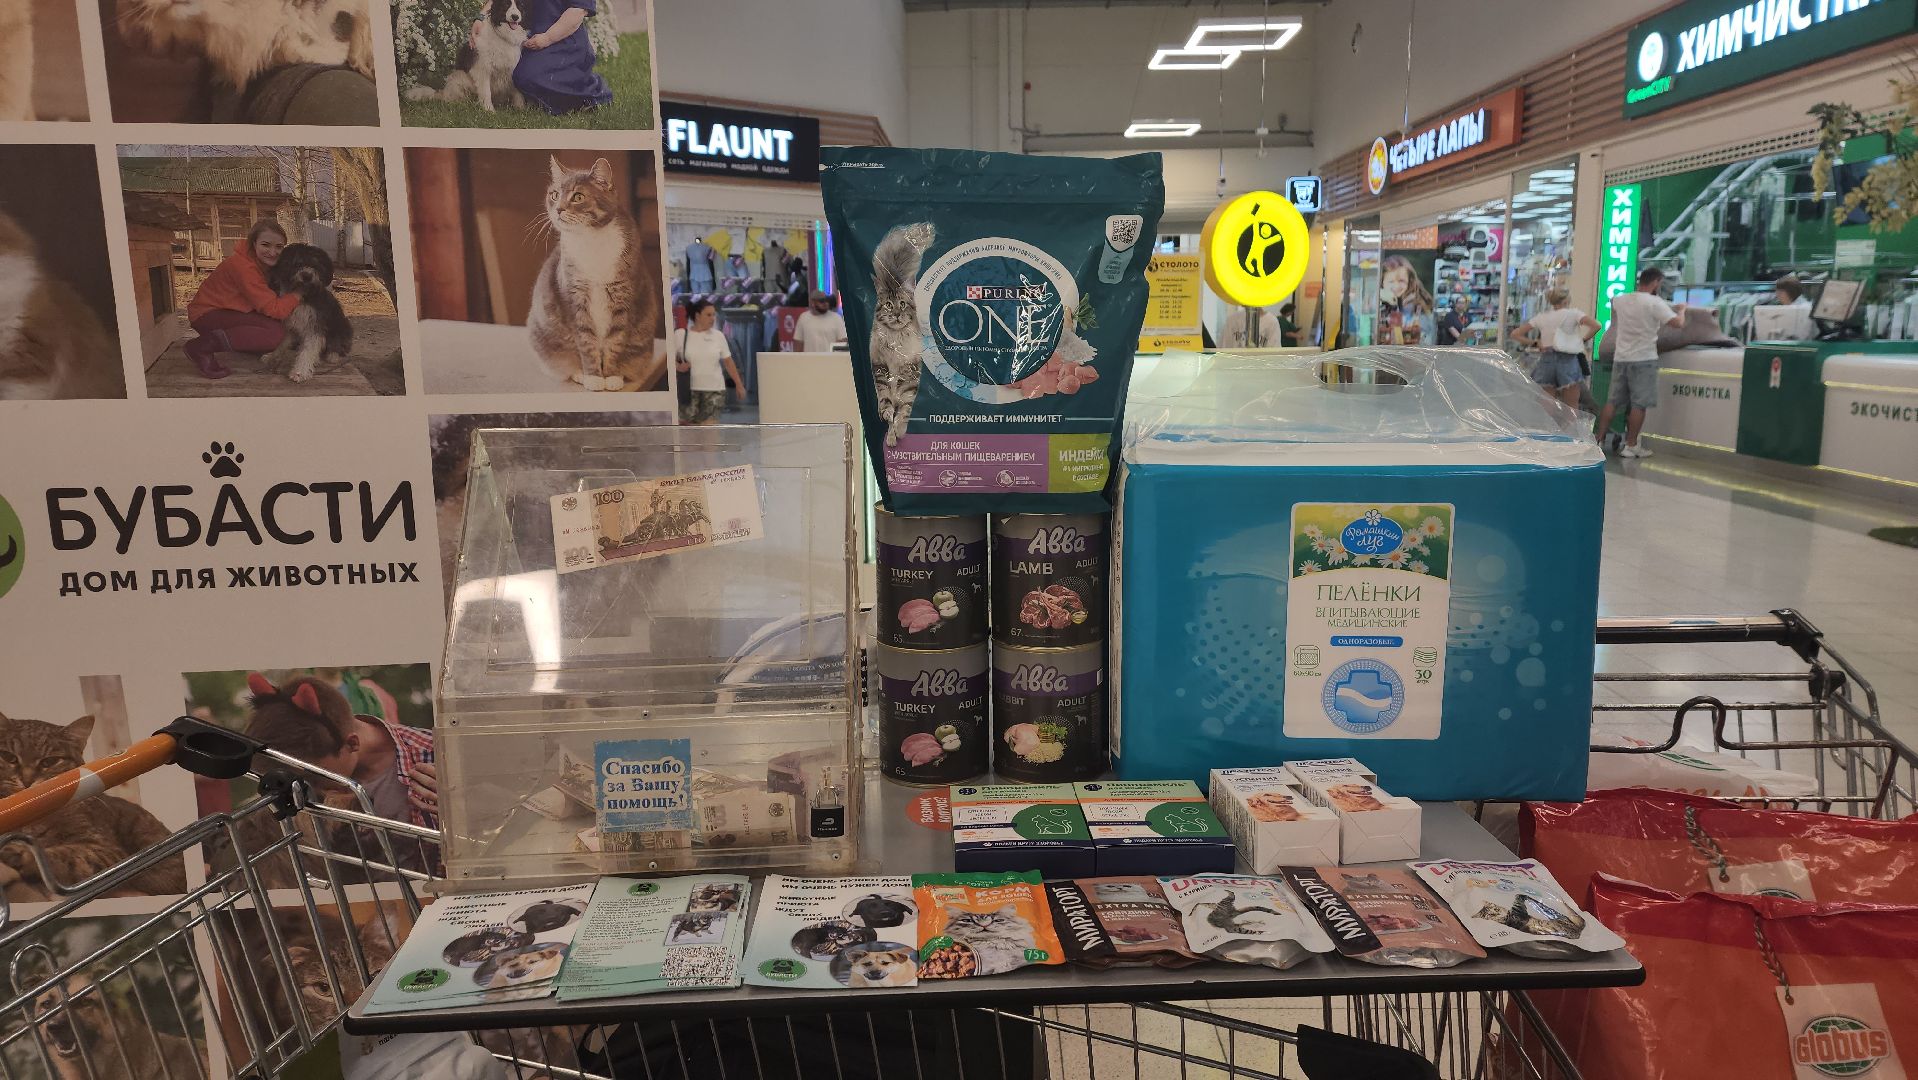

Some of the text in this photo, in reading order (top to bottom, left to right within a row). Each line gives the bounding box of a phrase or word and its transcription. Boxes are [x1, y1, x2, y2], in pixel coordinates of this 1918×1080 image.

[667, 118, 793, 162] FLAUNT
[1437, 108, 1484, 158] ЛАПЫ
[1160, 260, 1199, 269] СТОЛОТО
[939, 299, 1050, 344] ONE
[1671, 384, 1731, 400] ЭКОЧИСТКА
[929, 414, 1063, 424] ПОДДЕРЖИВАЕТ ИММУНИТЕТ
[930, 441, 980, 451] ДЛЯ КОШЕК
[892, 450, 962, 461] ЧУВСТВИТЕЛЬНЫМ
[964, 451, 1035, 463] ПИЩЕВАРЕНИЕМ
[592, 489, 625, 505] 100
[45, 481, 417, 555] БУБАСТИ
[890, 563, 981, 580] TURKEY ADULT
[1009, 560, 1053, 575] LAMB
[59, 562, 420, 597] ДОМ ДЛЯ ЖИВОТНЫХ
[1316, 582, 1421, 602] ПЕЛЁНКИ
[1315, 606, 1421, 619] ВПИТЫВАЮЩИЕ
[1327, 618, 1408, 628] МЕДИЦИНСКИЕ
[1337, 637, 1394, 646] ОДНОРАЗОВЫЕ
[1414, 669, 1432, 680] 30
[894, 696, 983, 714] TURKEY ADULT
[1057, 696, 1087, 708] ADULT
[605, 760, 681, 775] Спасибо
[607, 777, 681, 794] за Вашу
[606, 794, 684, 810] помощь!
[975, 886, 1032, 898] КОРМ
[1144, 903, 1171, 912] MEA
[1293, 873, 1367, 940] МИРАТОРГ
[1052, 887, 1104, 950] МИРАТОРГ
